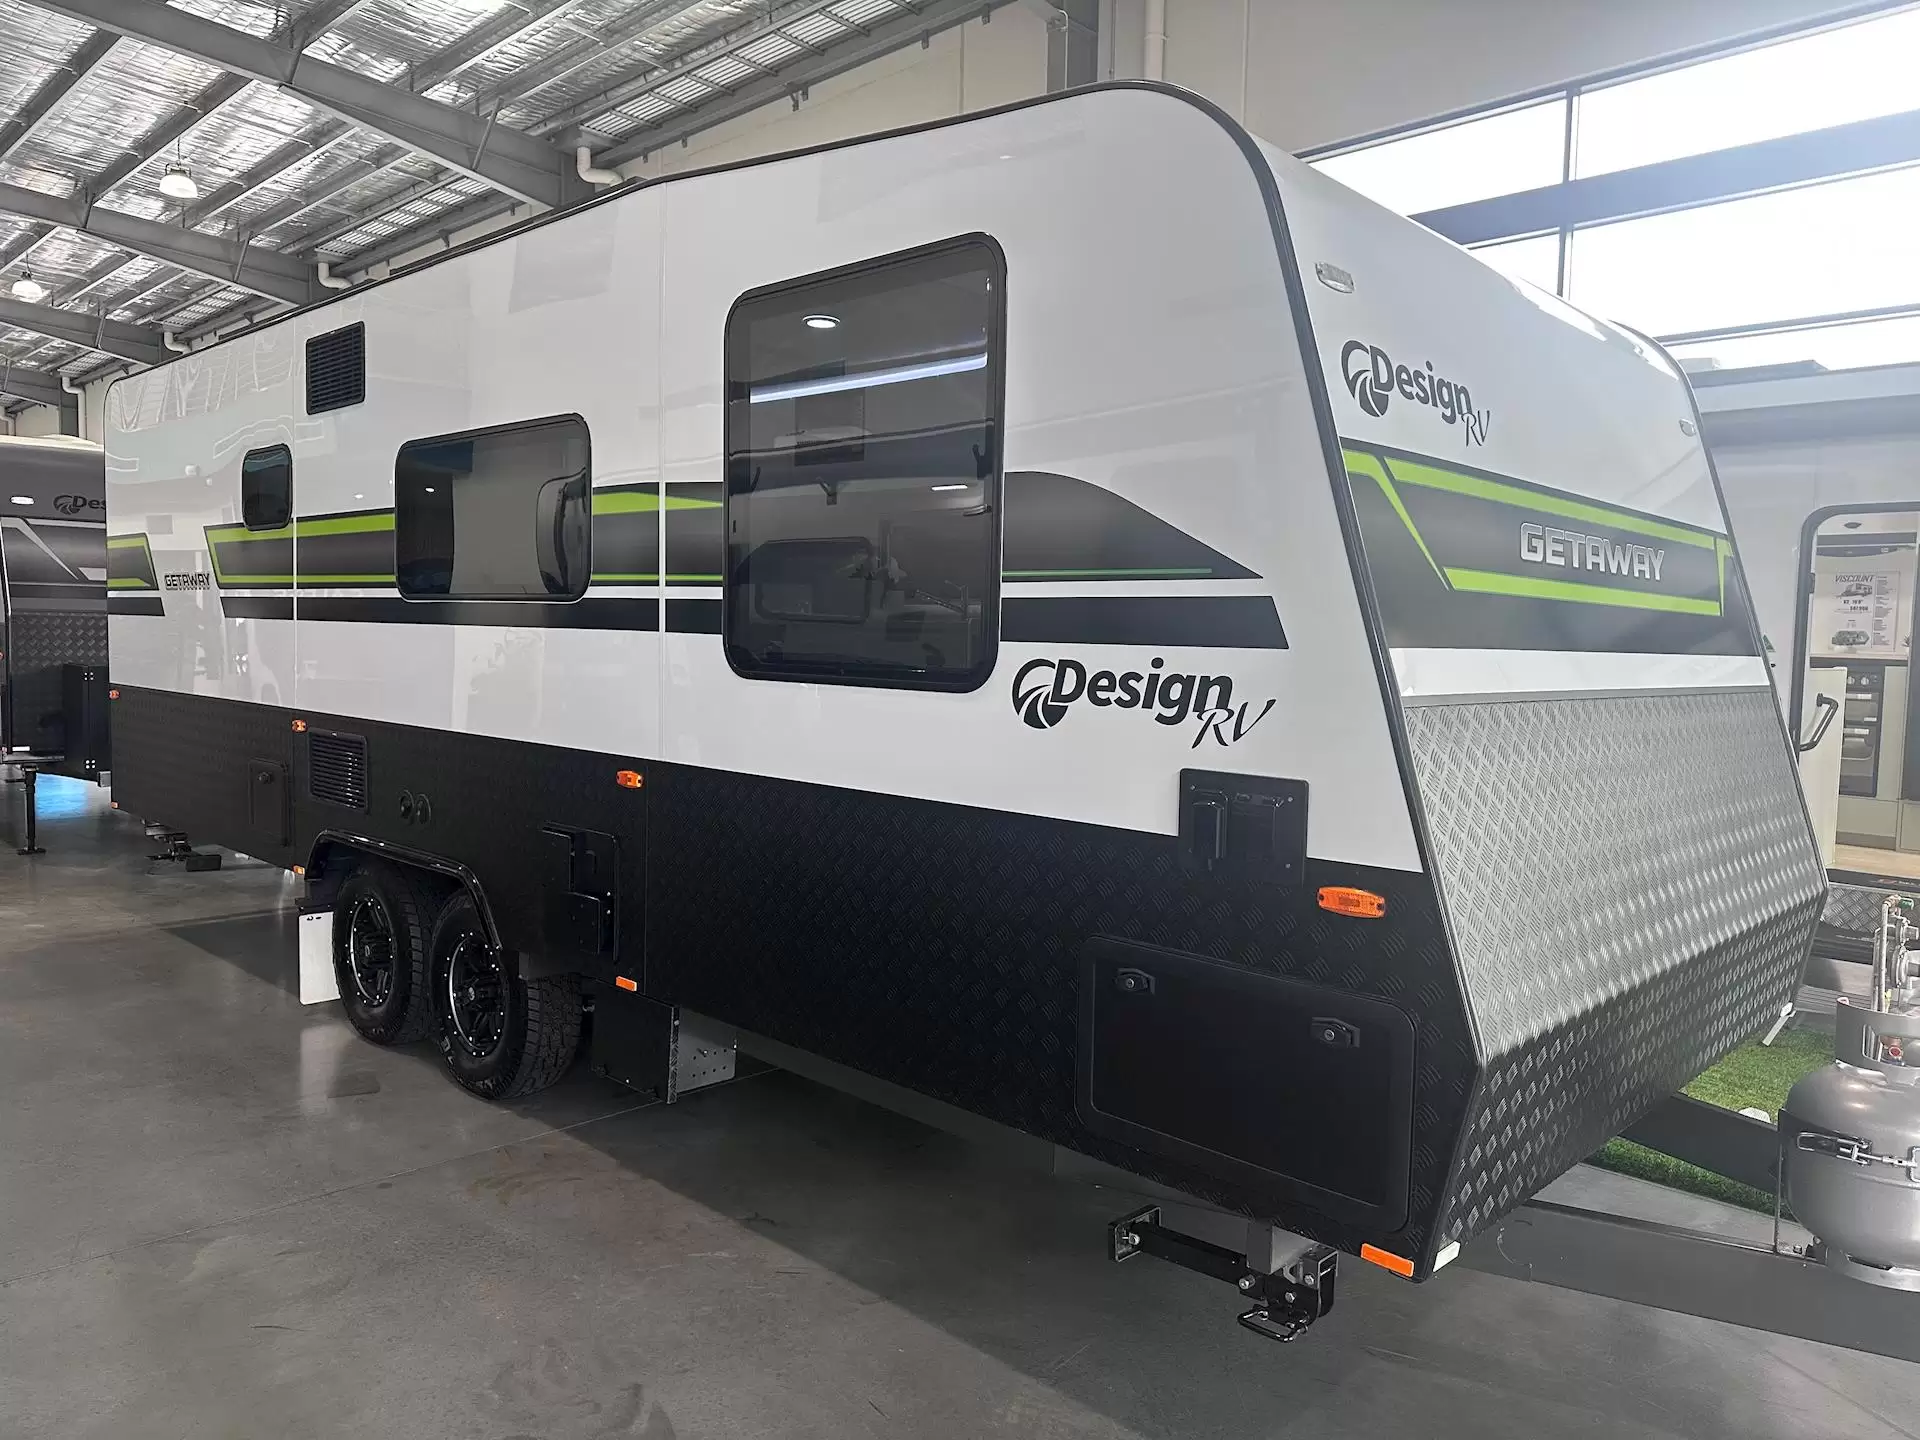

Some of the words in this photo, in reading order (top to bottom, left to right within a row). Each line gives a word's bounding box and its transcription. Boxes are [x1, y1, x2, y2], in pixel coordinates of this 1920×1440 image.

[1369, 345, 1472, 424] Design
[1460, 410, 1490, 447] RV
[164, 572, 210, 588] GETAWAY
[1520, 522, 1665, 581] GETAWAY
[1050, 657, 1233, 726] Design
[1191, 699, 1277, 749] RV
